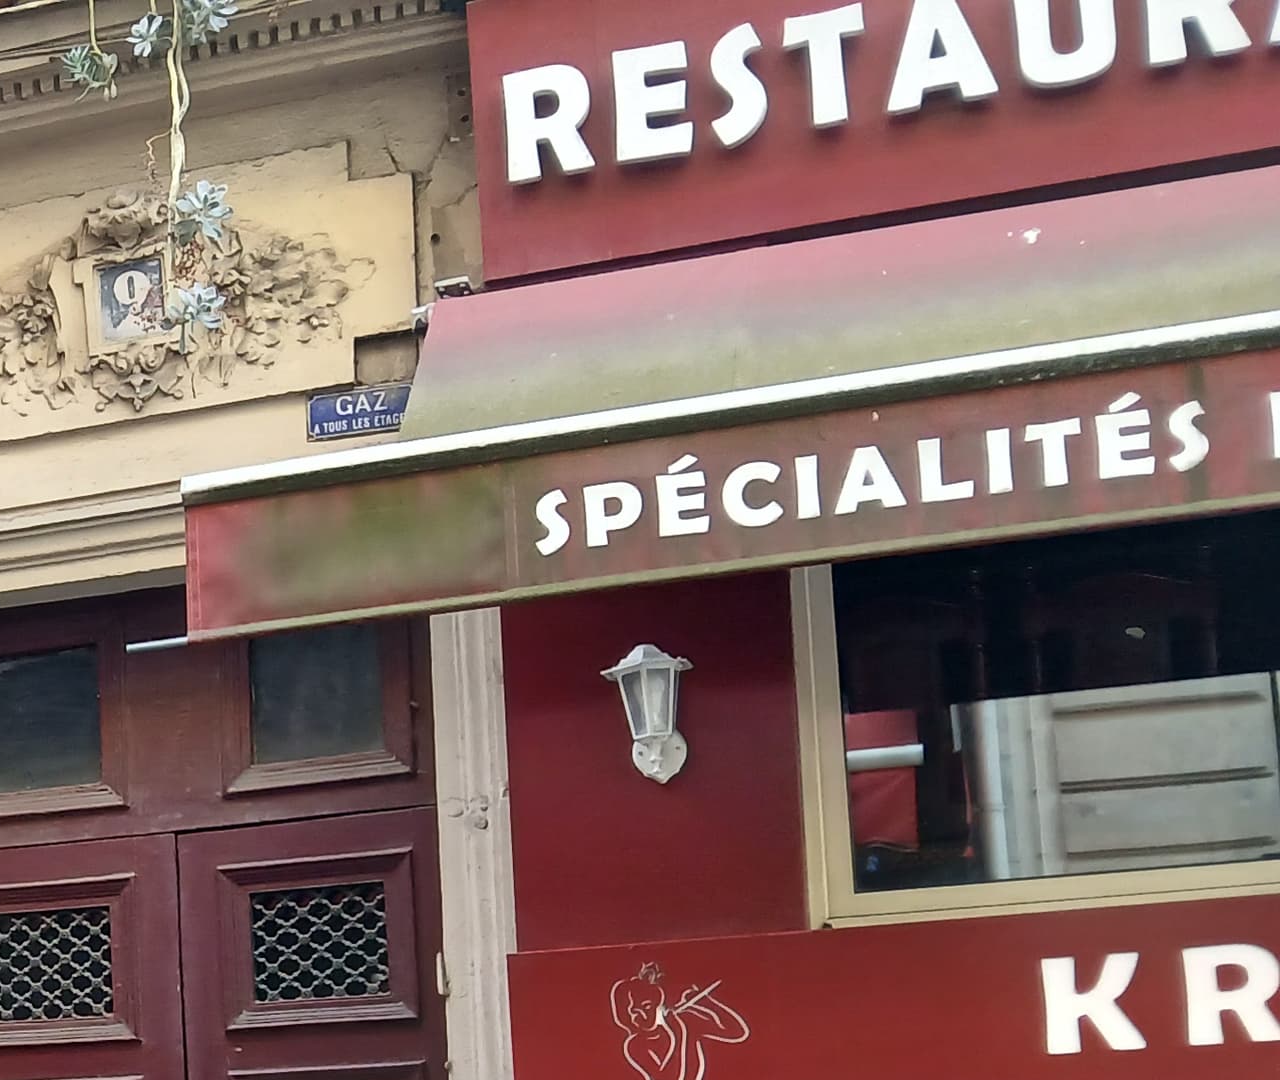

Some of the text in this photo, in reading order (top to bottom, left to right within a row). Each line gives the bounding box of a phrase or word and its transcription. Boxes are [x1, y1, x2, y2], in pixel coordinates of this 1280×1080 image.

[501, 0, 1280, 186] RESTAUR
[323, 420, 348, 433] TOUS
[352, 417, 370, 430] LES
[374, 412, 406, 427] ETAGE
[335, 391, 388, 416] GAZ
[535, 391, 1210, 558] SPÉCIALITÉS
